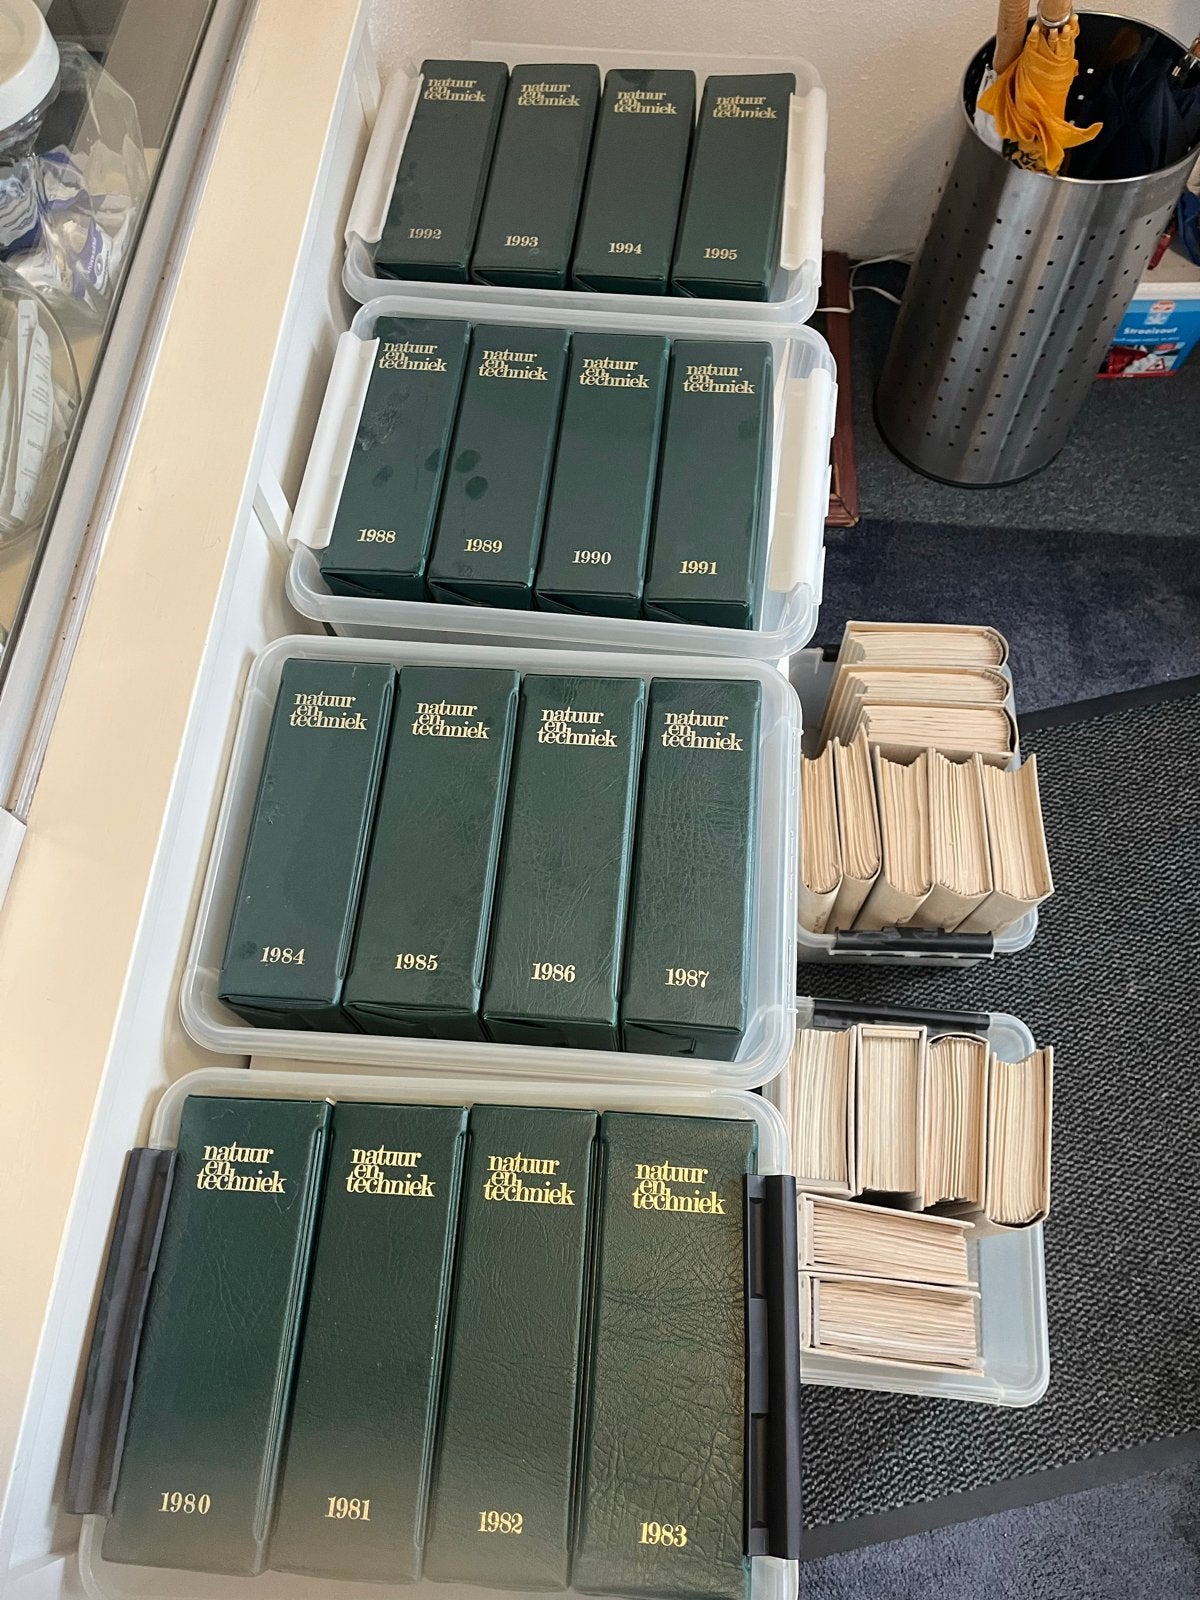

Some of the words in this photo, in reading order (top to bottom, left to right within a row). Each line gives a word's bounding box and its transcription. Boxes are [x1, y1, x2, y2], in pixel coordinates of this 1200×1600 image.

[428, 78, 477, 88] natuur
[521, 82, 570, 92] natuur
[424, 89, 486, 102] techniek
[518, 94, 580, 106] techniek
[523, 90, 541, 98] en
[617, 89, 667, 100] natuur
[716, 95, 767, 105] natuur
[614, 102, 677, 114] techniek
[619, 98, 638, 106] en
[718, 103, 736, 111] en
[712, 107, 777, 119] techniek
[408, 228, 441, 239] 1992
[504, 235, 538, 247] 1993
[608, 242, 642, 254] 1994
[703, 248, 738, 260] 1995
[383, 341, 438, 354] natuur
[482, 348, 538, 362] natuur
[385, 351, 405, 361] en
[583, 357, 638, 370] natuur
[379, 356, 447, 372] techniek
[484, 360, 505, 369] en
[686, 363, 743, 377] natuur
[479, 364, 548, 381] techniek
[579, 372, 650, 388] techniek
[585, 368, 606, 377] en
[689, 374, 710, 383] en
[683, 378, 755, 394] techniek
[357, 529, 396, 543] 1988
[464, 539, 502, 553] 1989
[572, 550, 611, 565] 1990
[679, 560, 718, 575] 1991
[293, 690, 356, 708] natuur
[296, 705, 319, 717] en
[415, 699, 478, 717] natuur
[540, 706, 604, 724] natuur
[289, 710, 368, 731] techniek
[418, 713, 441, 725] en
[664, 709, 729, 727] natuur
[411, 719, 491, 739] techniek
[544, 720, 567, 733] en
[668, 723, 691, 736] en
[537, 727, 618, 747] techniek
[661, 730, 744, 751] techniek
[260, 946, 305, 965] 1984
[395, 953, 438, 971] 1985
[531, 962, 576, 983] 1986
[665, 968, 709, 988] 1987
[202, 1141, 274, 1164] natuur
[350, 1144, 422, 1167] natuur
[205, 1160, 231, 1176] en
[353, 1163, 380, 1179] en
[487, 1152, 560, 1175] natuur
[491, 1171, 517, 1187] en
[634, 1160, 708, 1184] natuur
[196, 1167, 287, 1193] techniek
[345, 1170, 436, 1197] techniek
[640, 1180, 666, 1195] en
[483, 1178, 576, 1206] techniek
[631, 1187, 726, 1215] techniek
[158, 1491, 210, 1514] 1980
[325, 1496, 370, 1521] 1981
[478, 1510, 523, 1534] 1982
[638, 1521, 687, 1547] 1983
